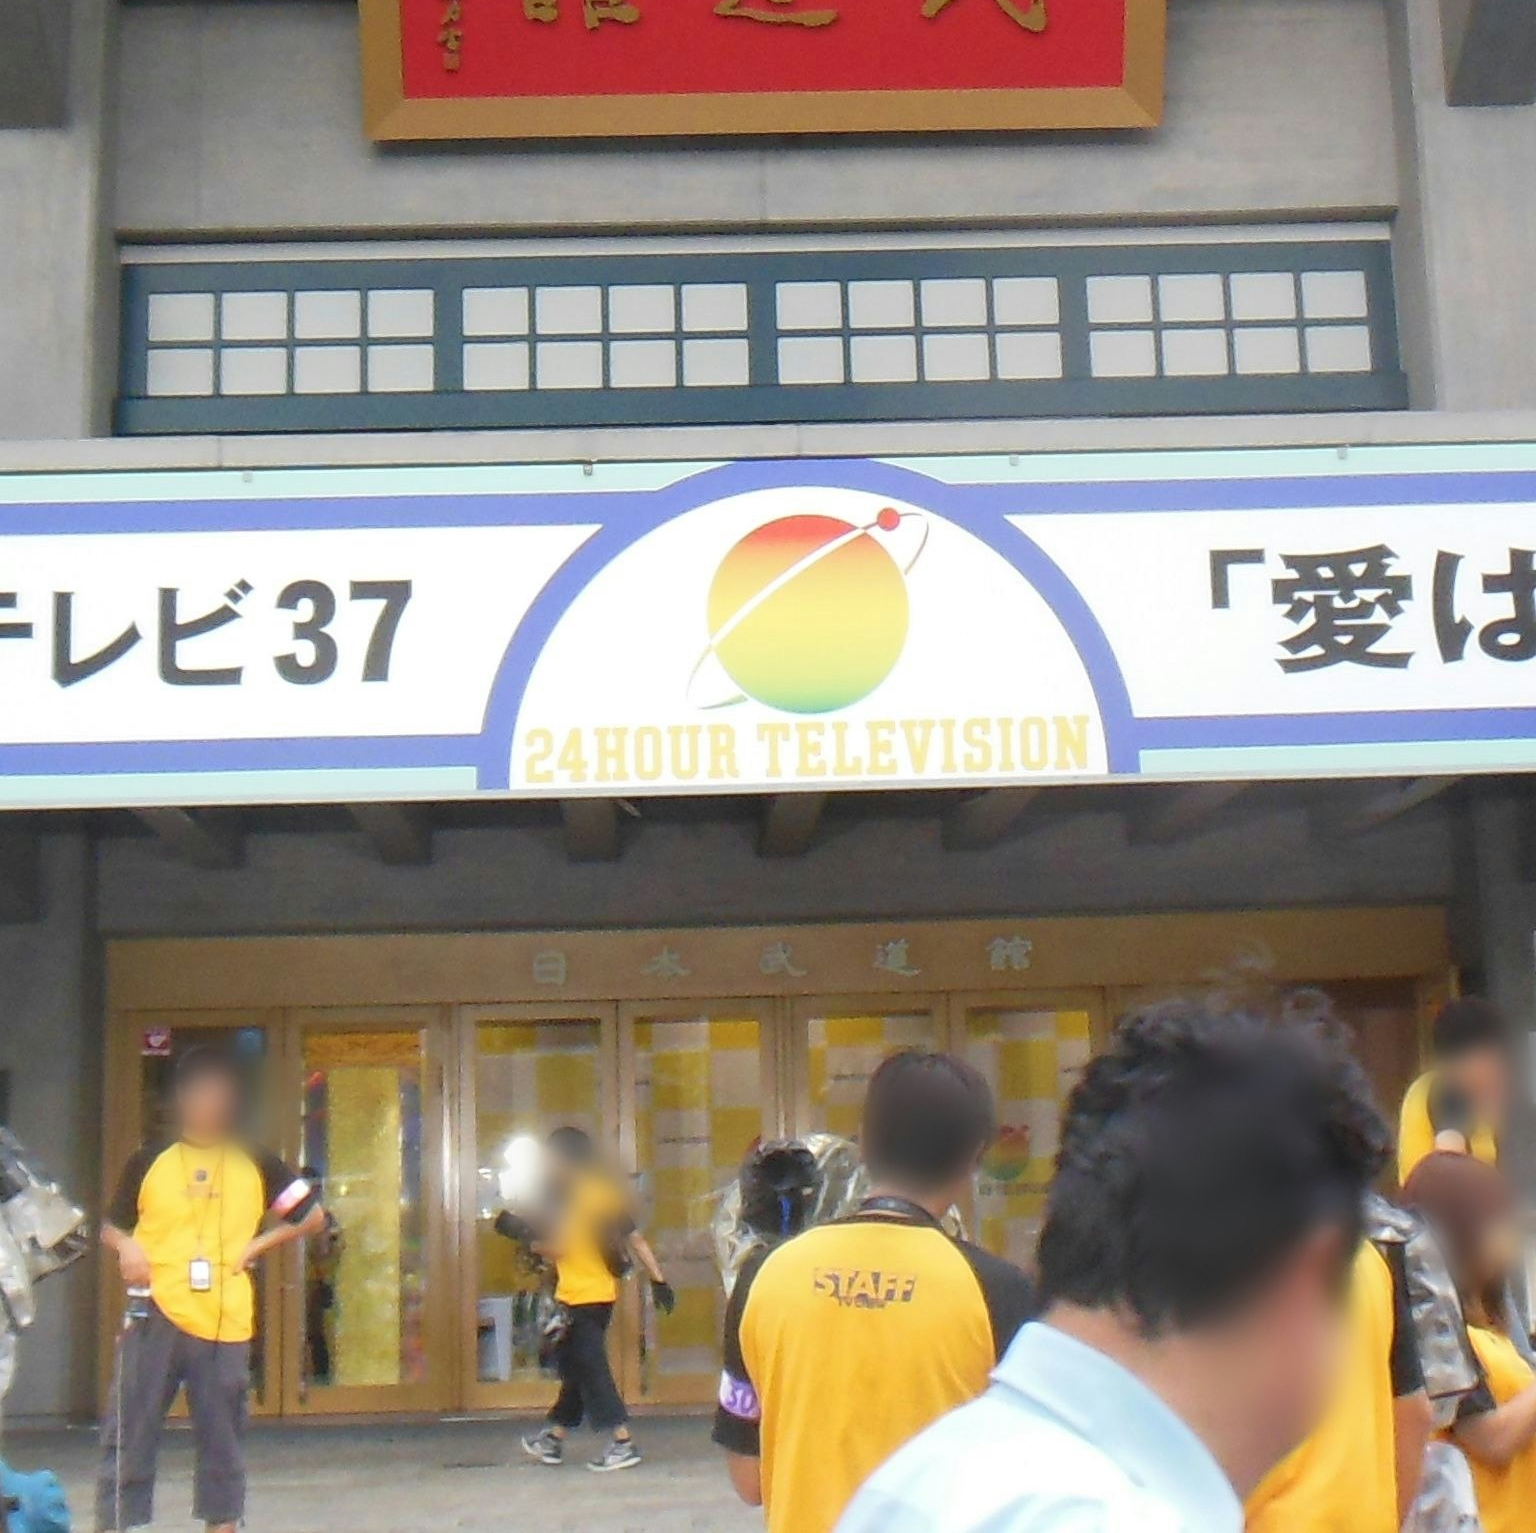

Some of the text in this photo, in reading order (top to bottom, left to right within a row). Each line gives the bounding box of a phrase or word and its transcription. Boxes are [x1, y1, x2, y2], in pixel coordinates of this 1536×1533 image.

[524, 715, 1090, 784] 24HOUR TELEVISION
[812, 1267, 918, 1303] STAFF
